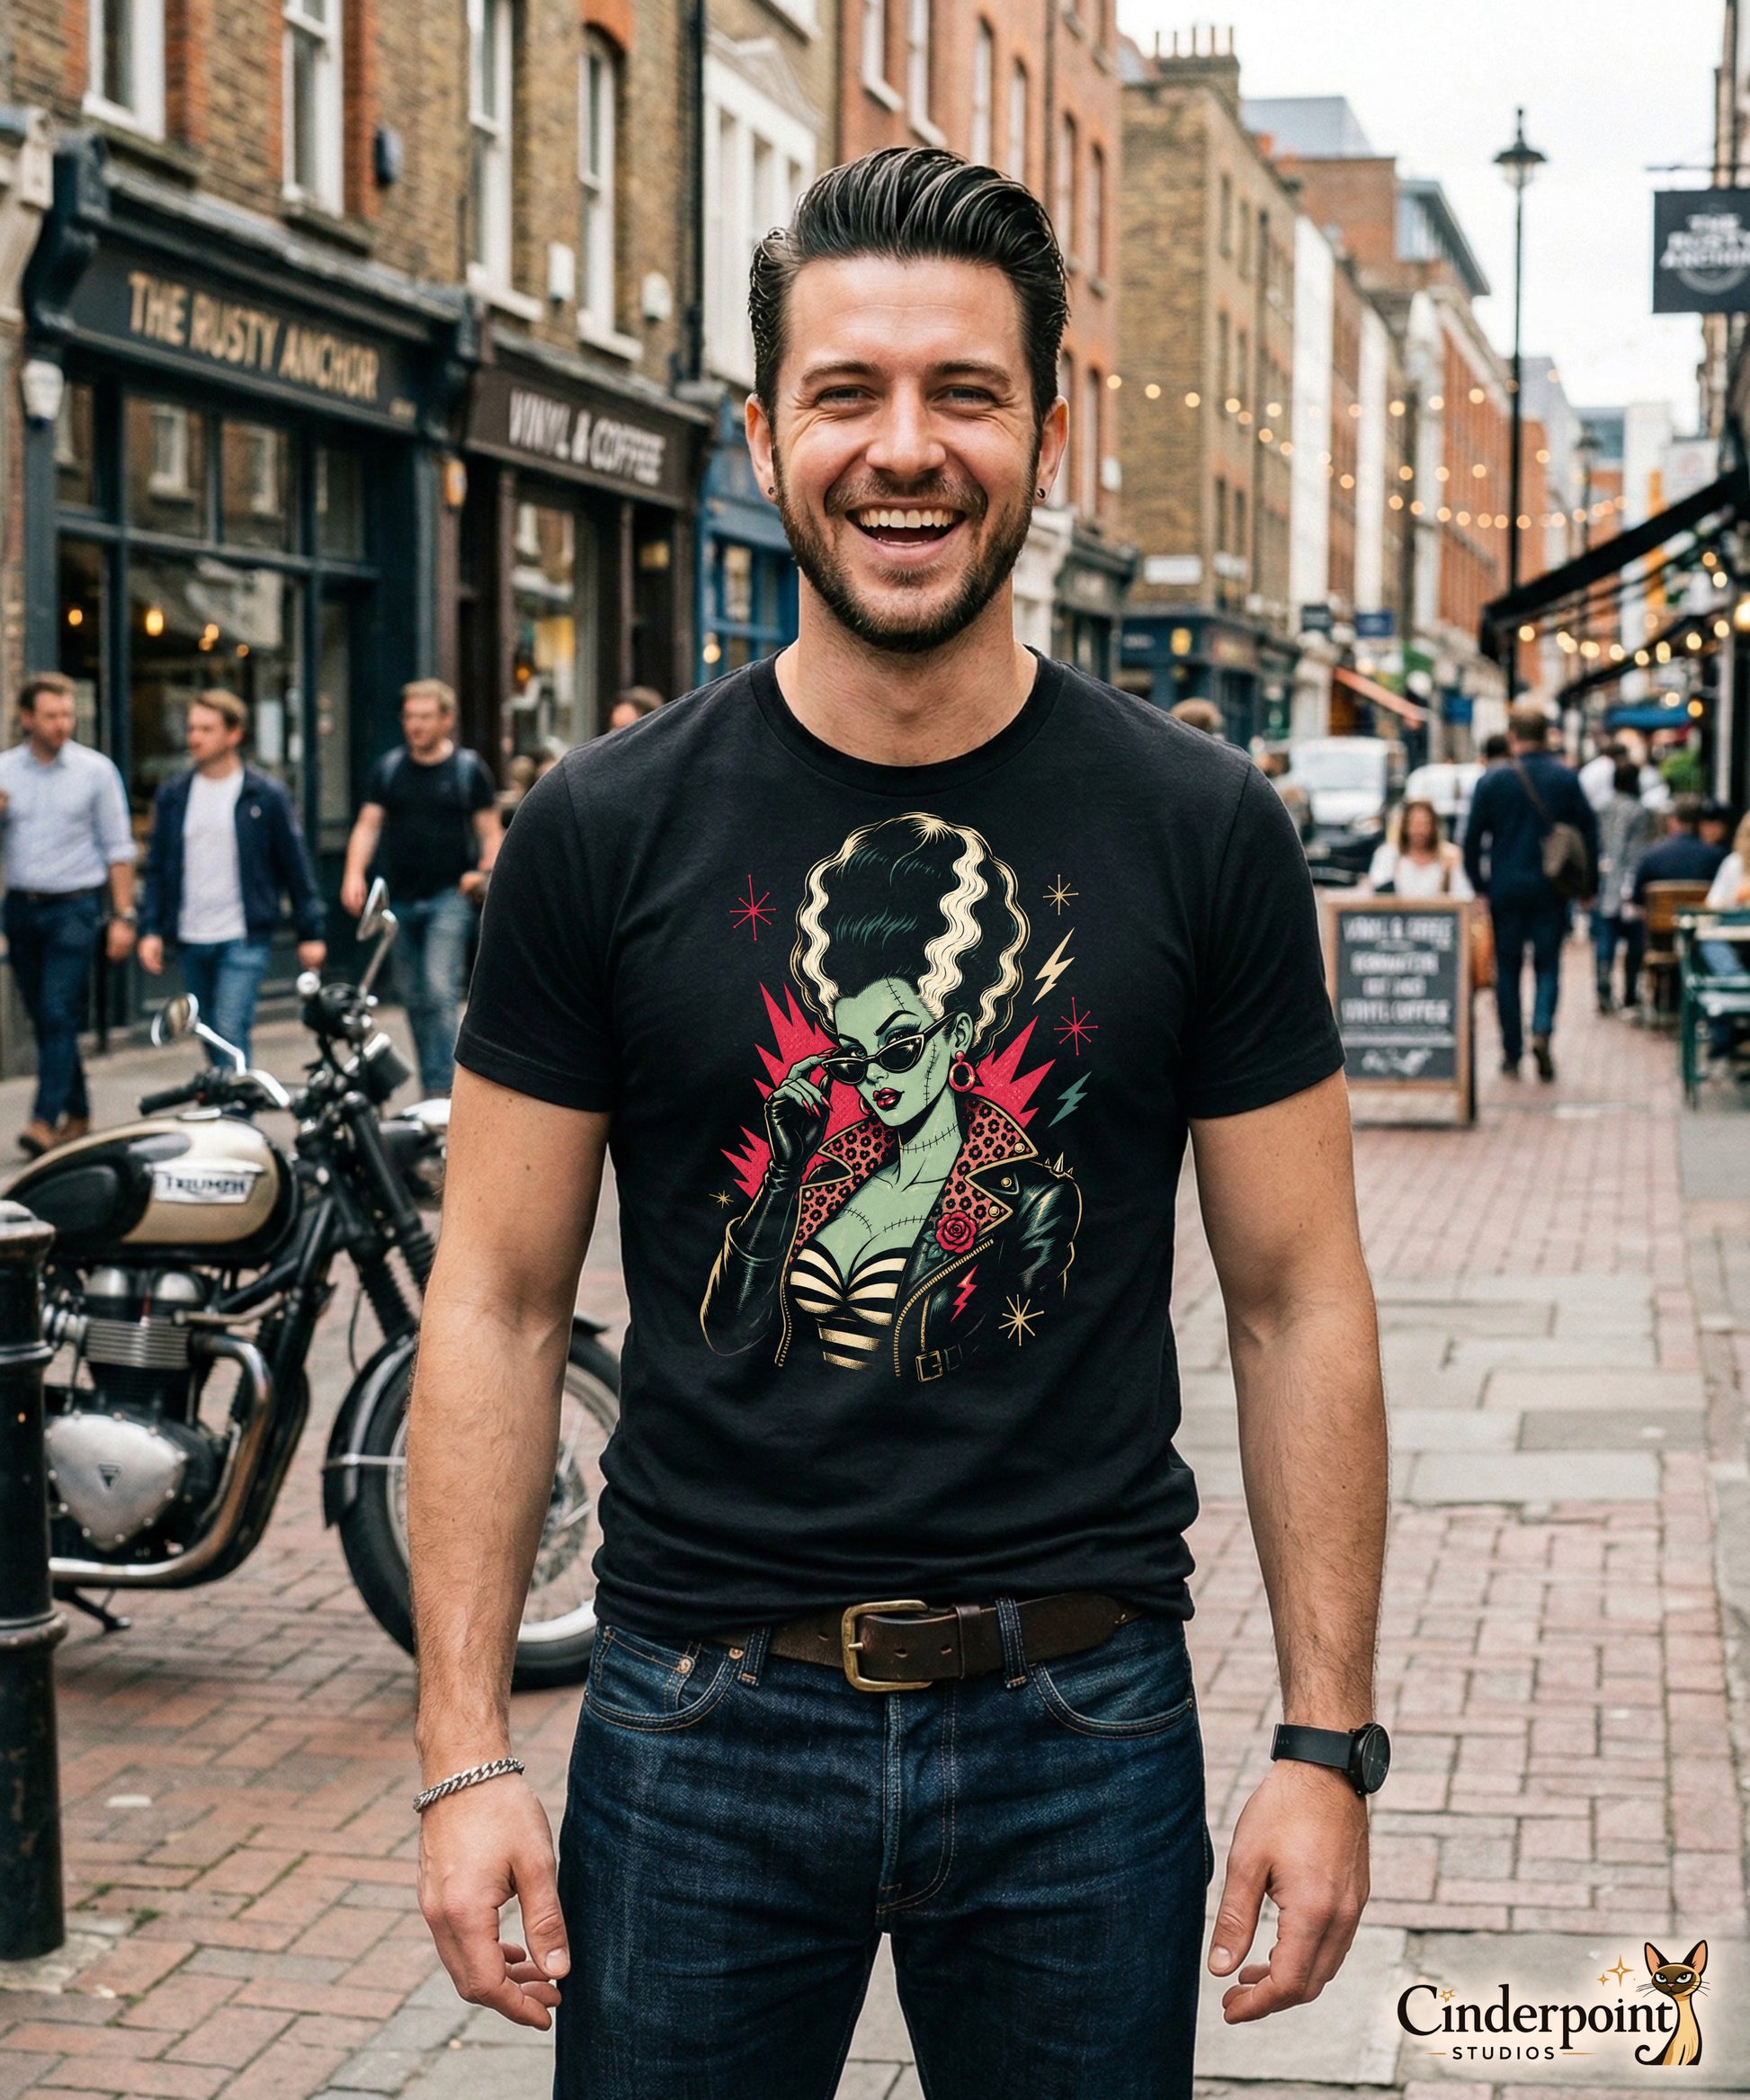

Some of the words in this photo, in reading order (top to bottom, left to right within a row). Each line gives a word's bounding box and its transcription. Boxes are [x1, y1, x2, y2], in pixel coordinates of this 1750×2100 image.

[129, 271, 188, 347] THE
[190, 290, 279, 371] RUSTY
[278, 323, 379, 402] ANCHOR
[509, 389, 570, 460] VINYL
[571, 409, 592, 464] &
[590, 416, 666, 487] COFFEE
[165, 1175, 246, 1194] TRIUMPH
